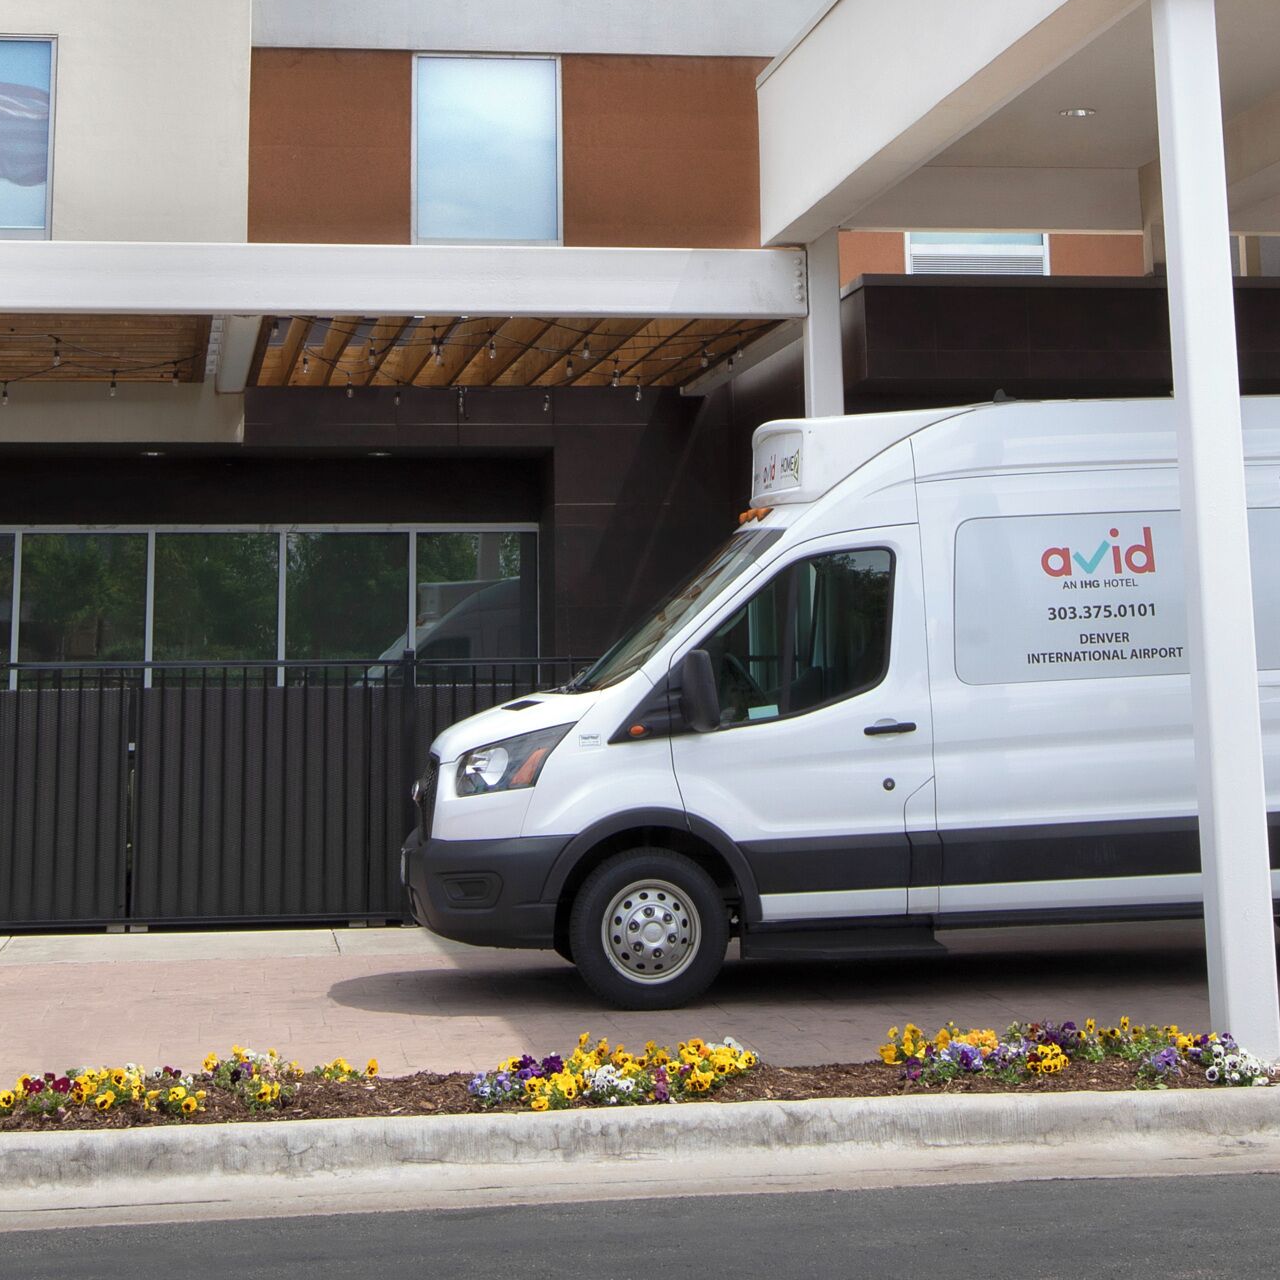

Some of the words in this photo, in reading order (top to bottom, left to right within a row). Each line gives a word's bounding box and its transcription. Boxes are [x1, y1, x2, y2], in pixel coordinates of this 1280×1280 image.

[1041, 526, 1156, 577] avid
[1062, 581, 1078, 590] AN
[1080, 579, 1101, 589] IHG
[1104, 578, 1139, 588] HOTEL
[1047, 603, 1157, 621] 303.375.0101
[1079, 631, 1131, 645] DENVER
[1027, 649, 1128, 665] INTERNATIONAL
[1130, 646, 1184, 660] AIRPORT
